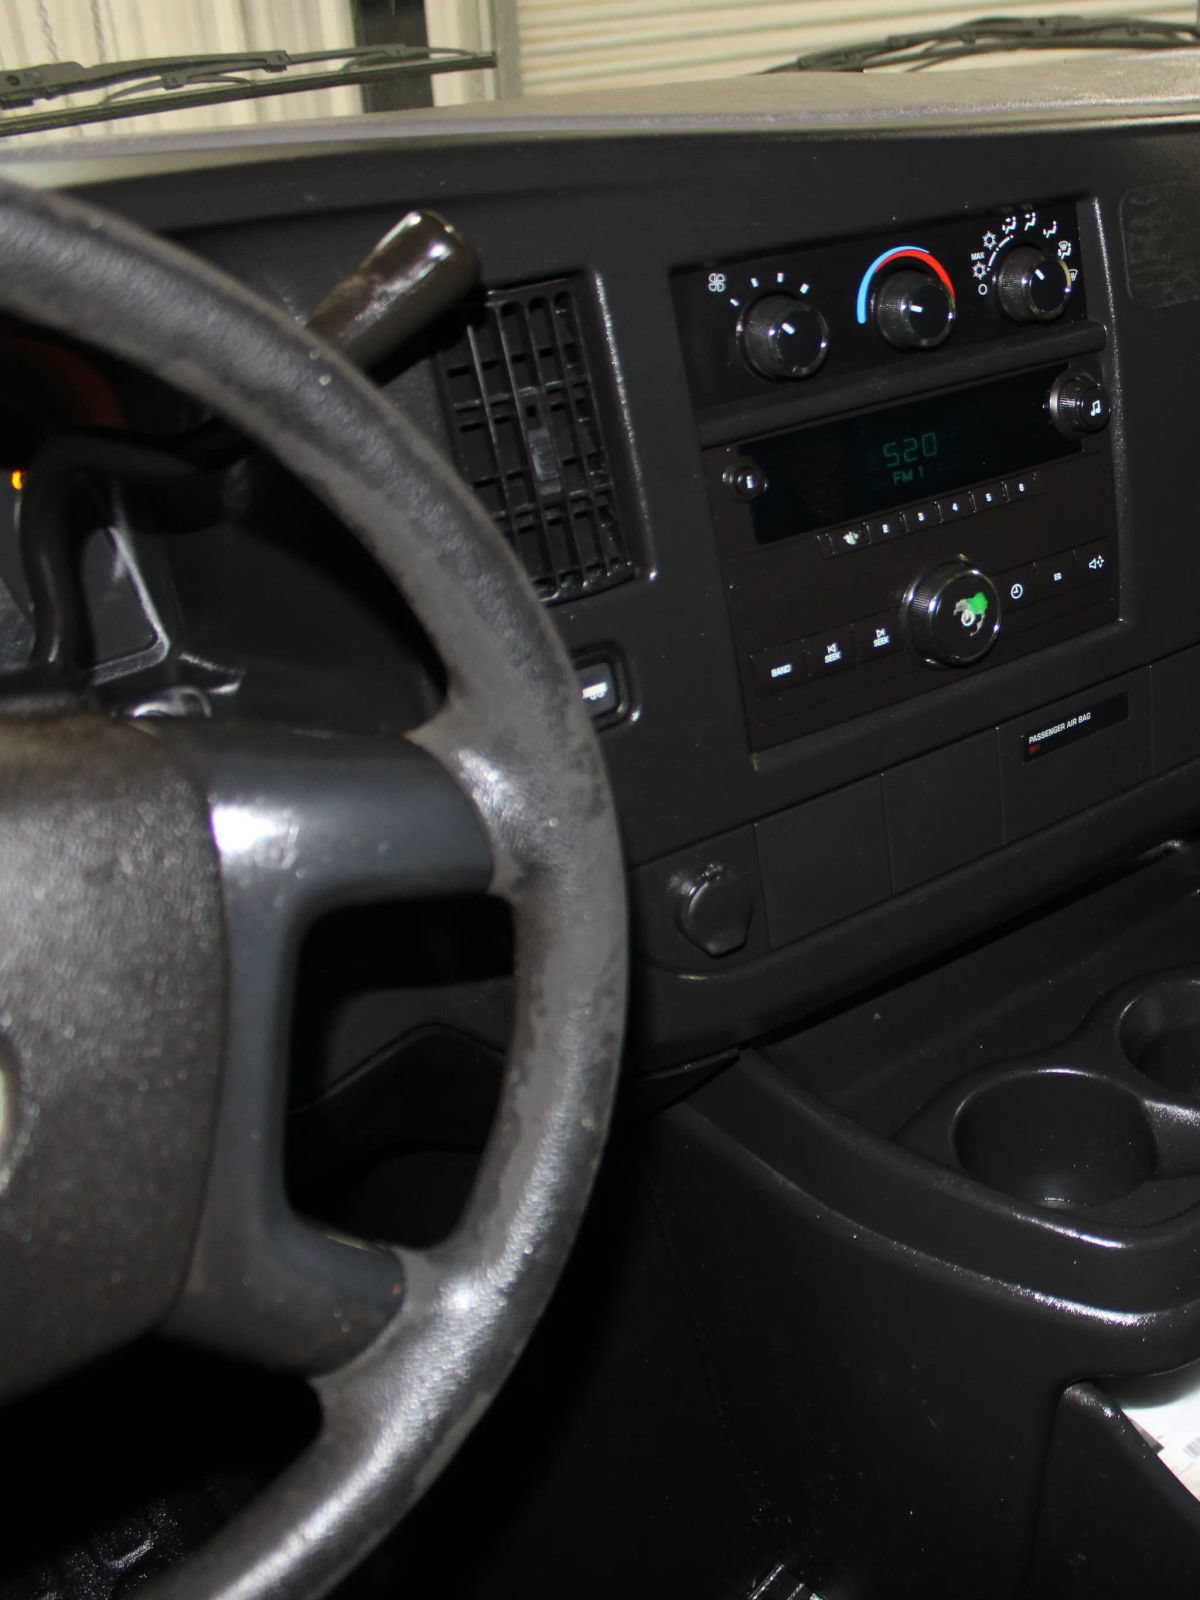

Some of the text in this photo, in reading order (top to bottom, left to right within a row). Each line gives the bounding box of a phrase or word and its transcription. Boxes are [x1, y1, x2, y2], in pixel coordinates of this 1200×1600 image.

[970, 251, 985, 261] MAX
[985, 493, 993, 502] 5
[951, 502, 959, 512] 4
[917, 511, 925, 522] 3
[882, 523, 890, 534] 2
[873, 635, 891, 648] SEEK
[824, 651, 843, 664] SEEK
[770, 663, 793, 678] BAND
[1028, 711, 1092, 745] PASSENGER AIR BAG
